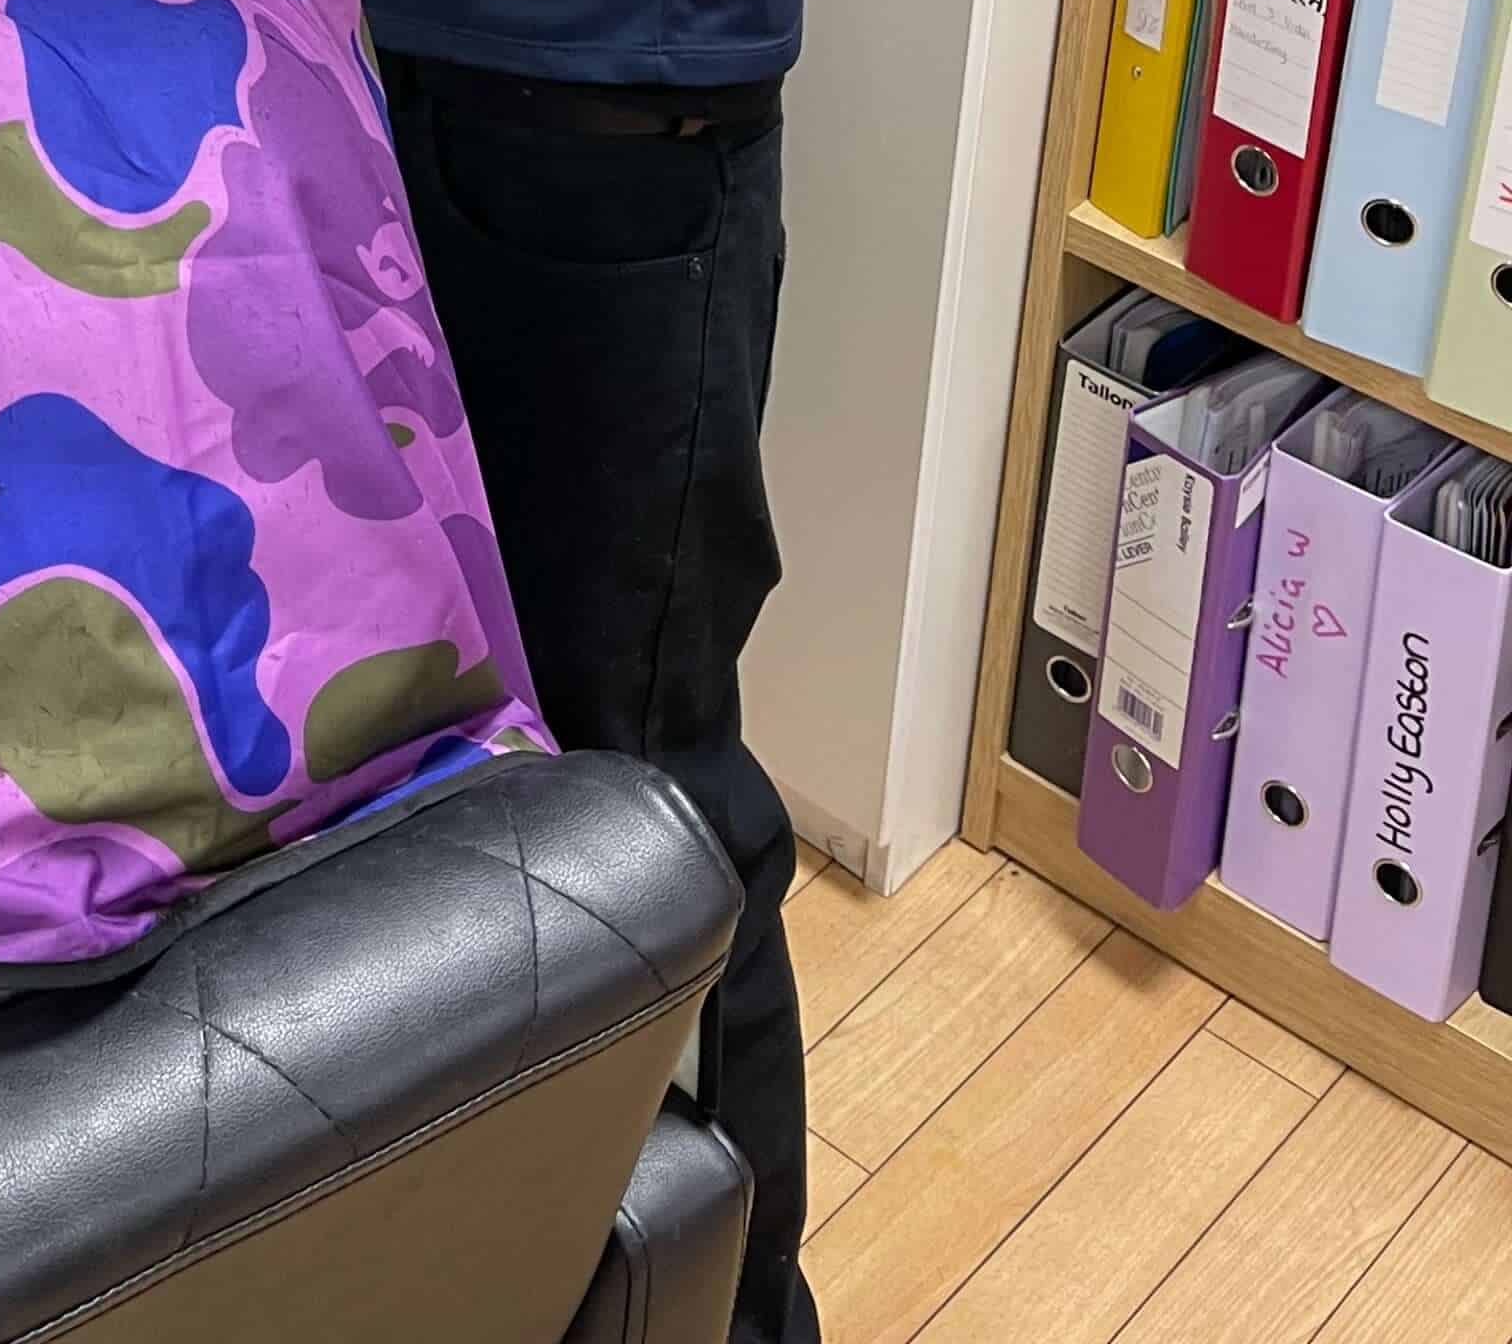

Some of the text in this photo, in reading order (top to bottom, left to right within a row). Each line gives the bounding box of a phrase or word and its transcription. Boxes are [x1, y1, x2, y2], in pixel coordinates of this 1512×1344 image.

[1079, 372, 1134, 409] Tallon
[1376, 632, 1433, 854] Holly Easton
